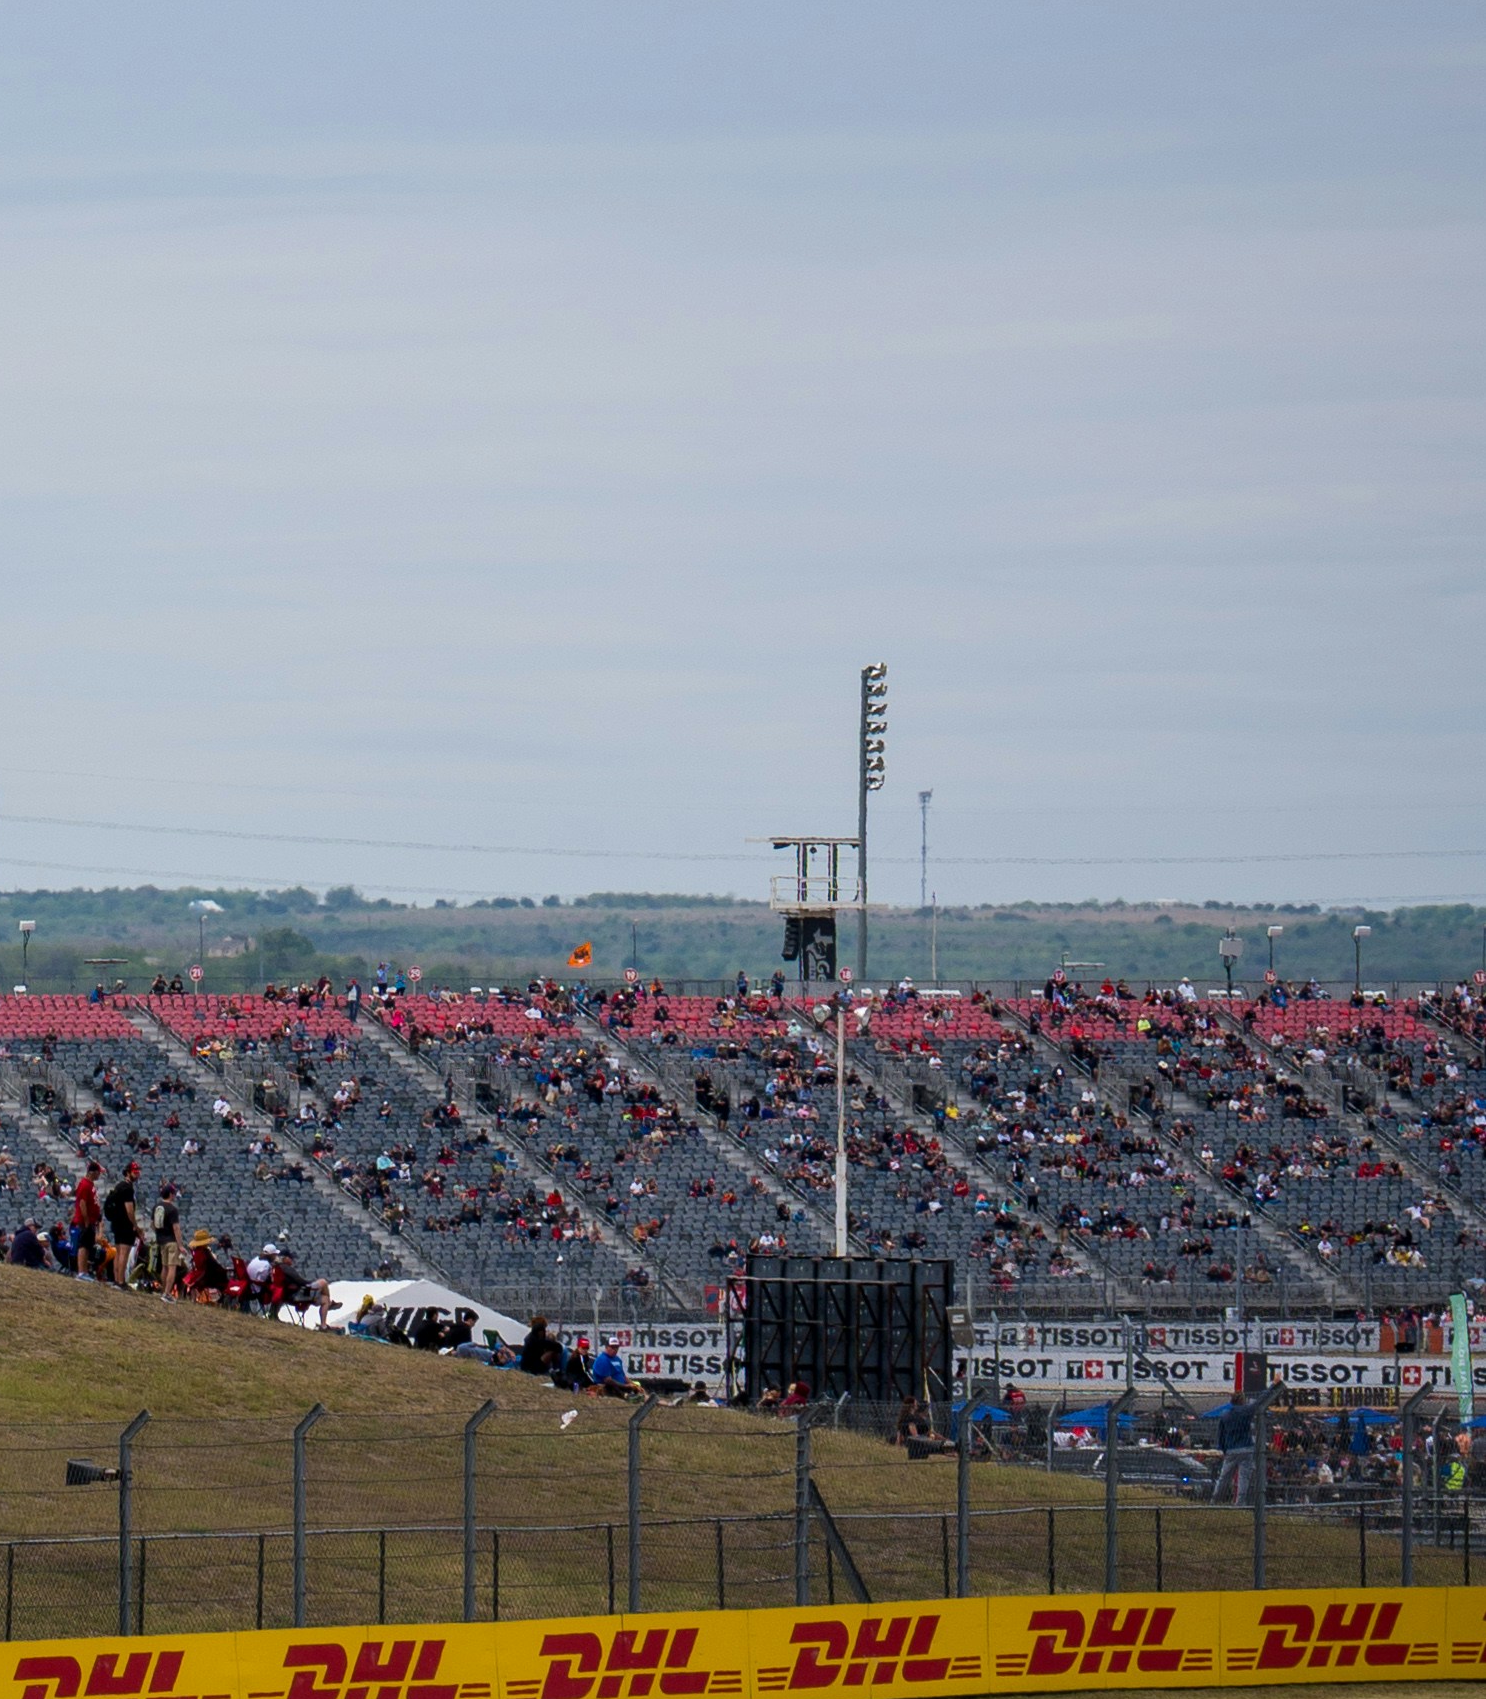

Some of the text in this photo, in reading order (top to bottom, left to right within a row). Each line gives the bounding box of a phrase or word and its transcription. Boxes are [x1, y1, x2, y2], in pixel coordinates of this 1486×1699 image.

[635, 1330, 723, 1348] TISSOT
[1037, 1328, 1121, 1346] TISSOT
[1169, 1328, 1253, 1346] TISSOT
[1297, 1328, 1375, 1346] TISSOT
[789, 1615, 950, 1689] DHL
[1028, 1608, 1183, 1675] DHL
[1258, 1603, 1409, 1668] DHL
